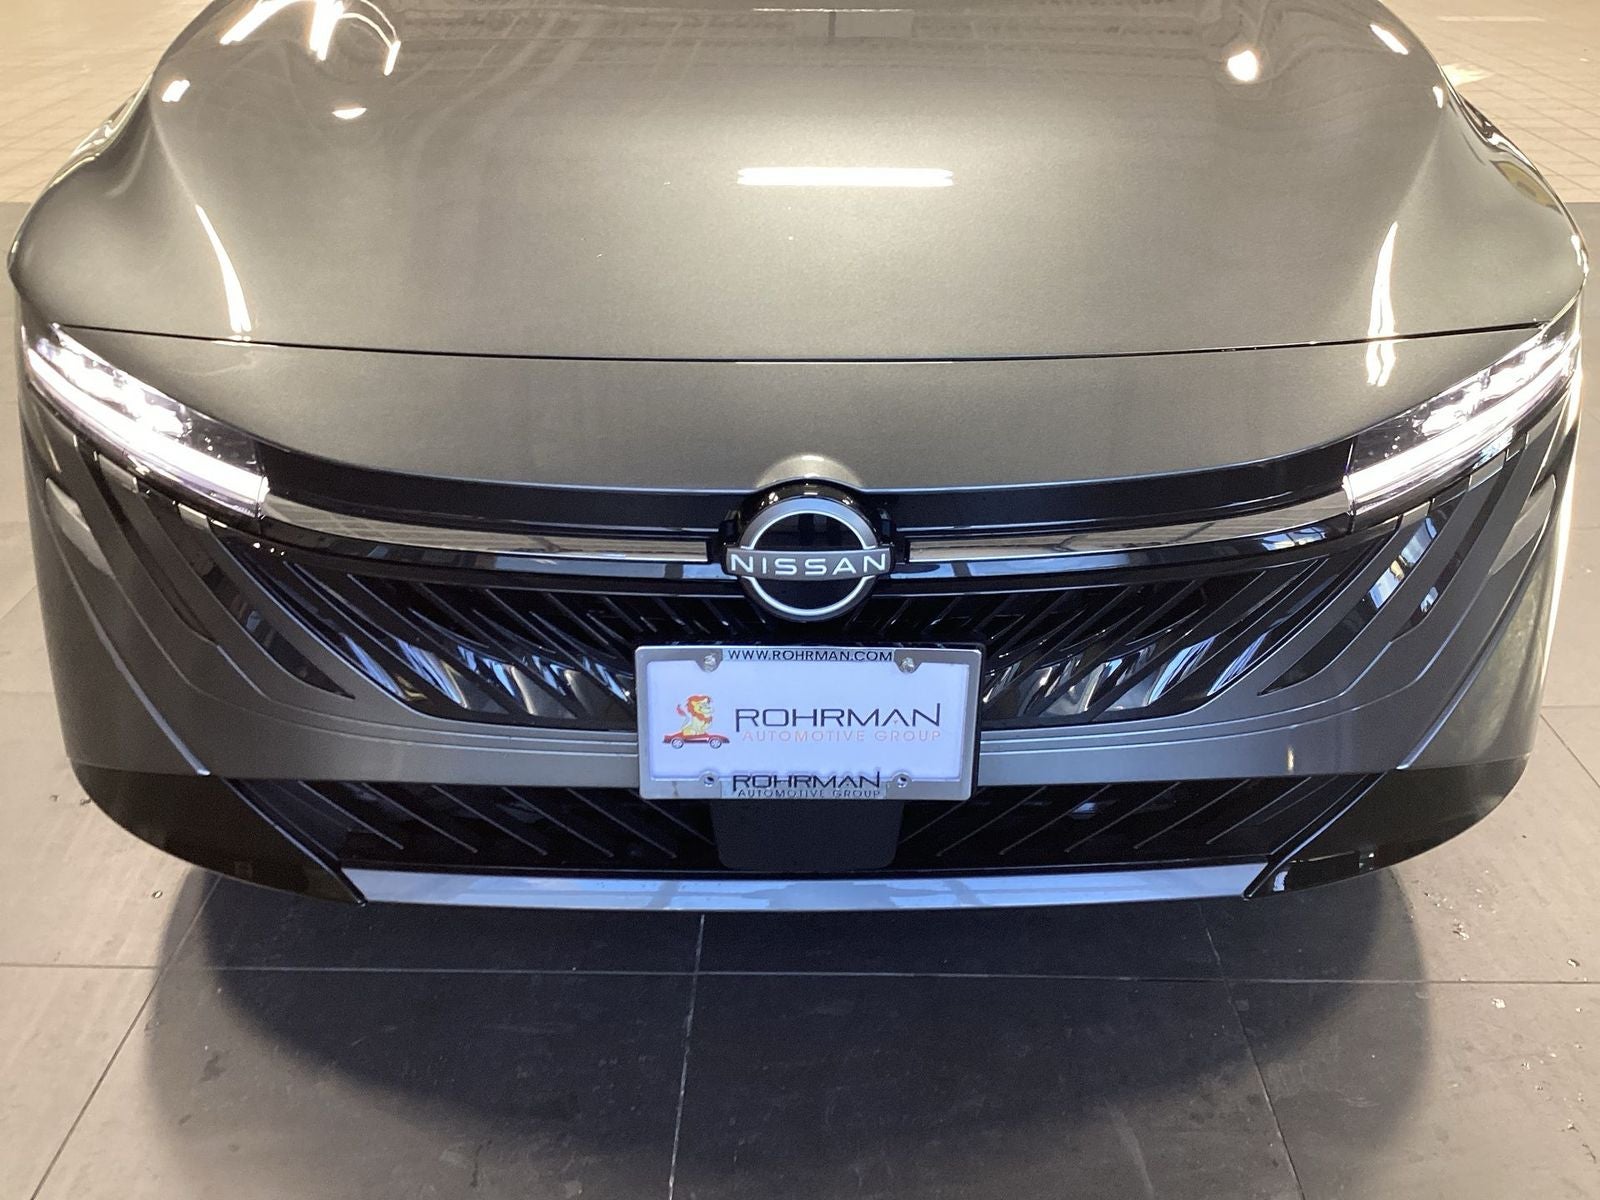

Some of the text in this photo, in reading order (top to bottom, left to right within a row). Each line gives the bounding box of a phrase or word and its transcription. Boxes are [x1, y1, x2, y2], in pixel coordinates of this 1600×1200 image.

[731, 553, 886, 575] NISSAN
[728, 649, 893, 662] WWW.ROHRMAN.COM
[735, 703, 941, 732] ROHRMAN
[743, 730, 941, 743] AUTOMOTIVE GROUP
[733, 771, 880, 791] ROHRMAN
[738, 789, 880, 798] AUTOMOTIVE GROUP
